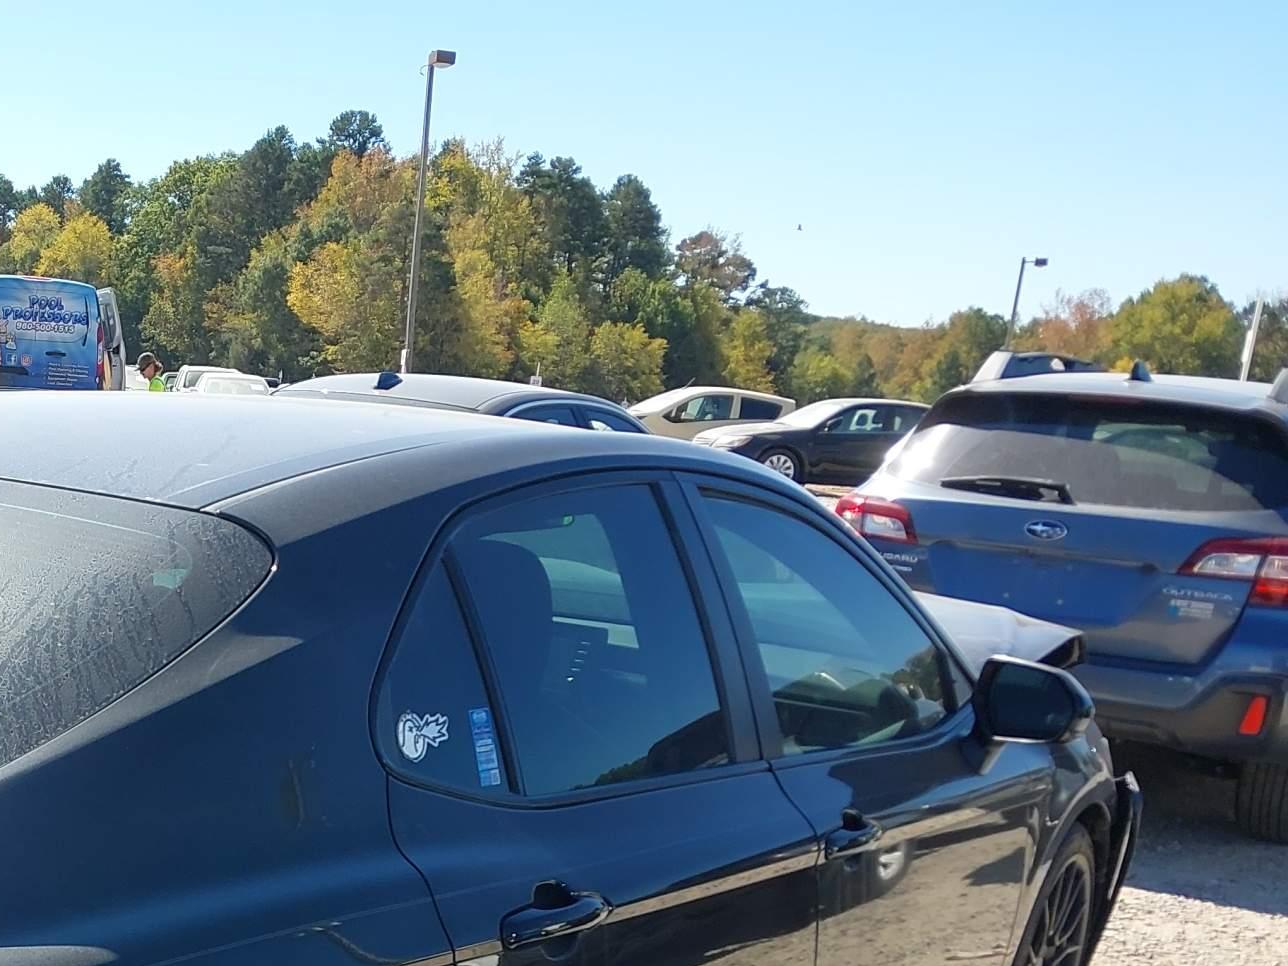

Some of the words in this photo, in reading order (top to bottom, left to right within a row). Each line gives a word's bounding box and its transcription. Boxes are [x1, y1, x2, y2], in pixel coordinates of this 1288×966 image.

[29, 295, 64, 310] POOL
[2, 306, 89, 325] PROFESSORS
[880, 552, 918, 563] UBARU
